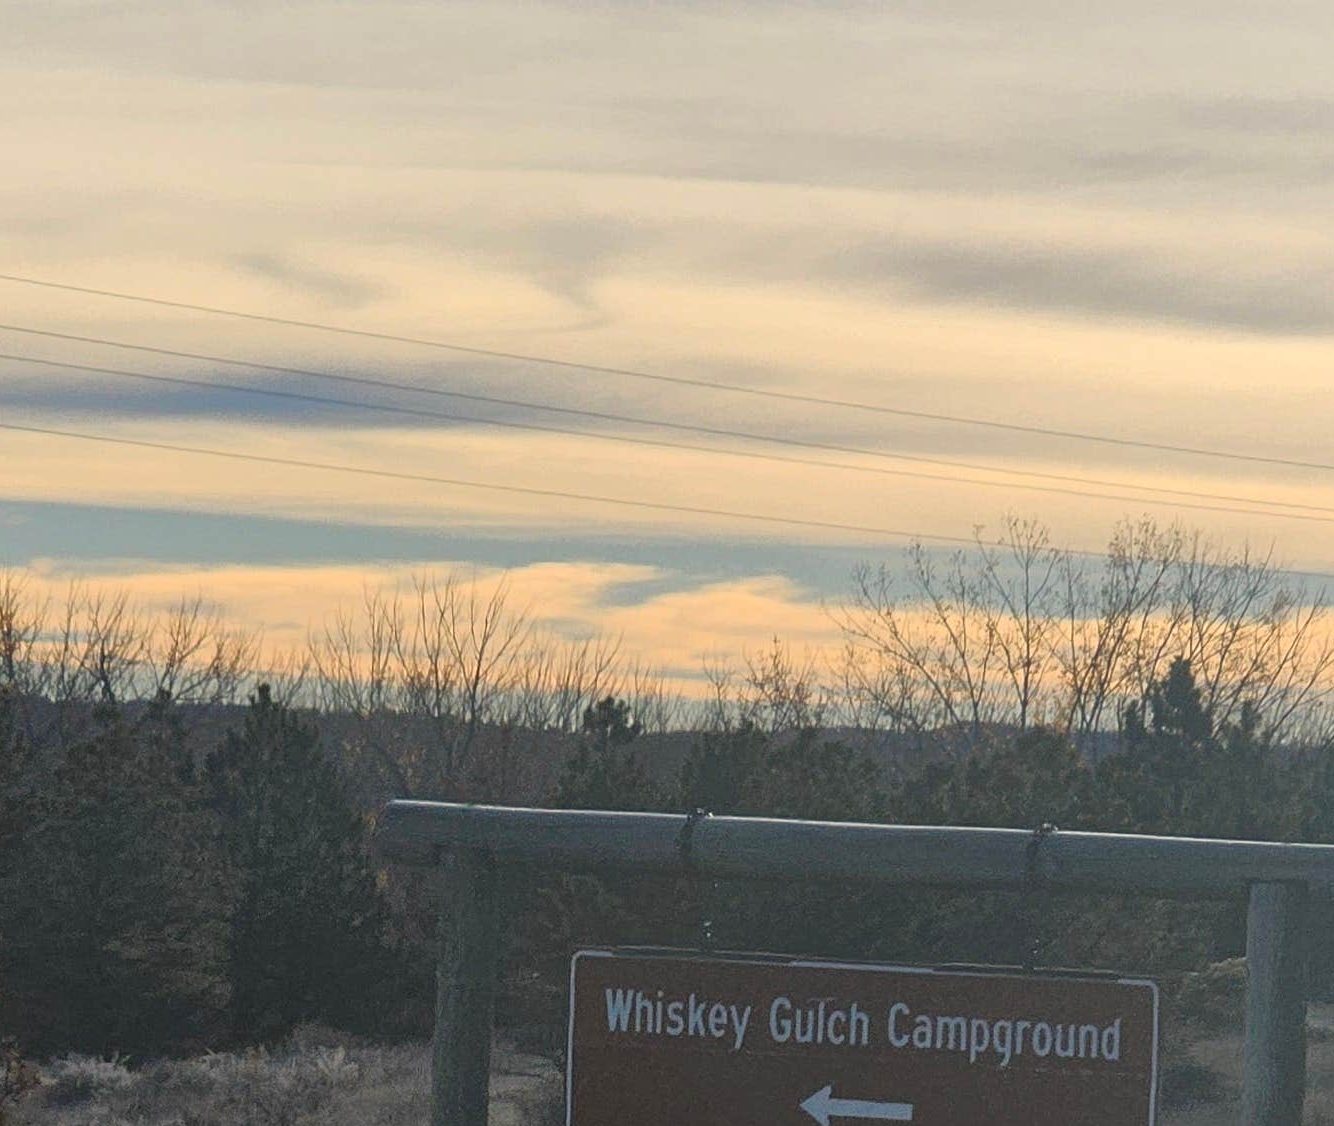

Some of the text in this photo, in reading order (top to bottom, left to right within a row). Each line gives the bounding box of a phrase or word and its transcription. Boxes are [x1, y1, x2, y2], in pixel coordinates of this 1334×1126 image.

[605, 988, 1121, 1067] Whiskey Gulch Campground
